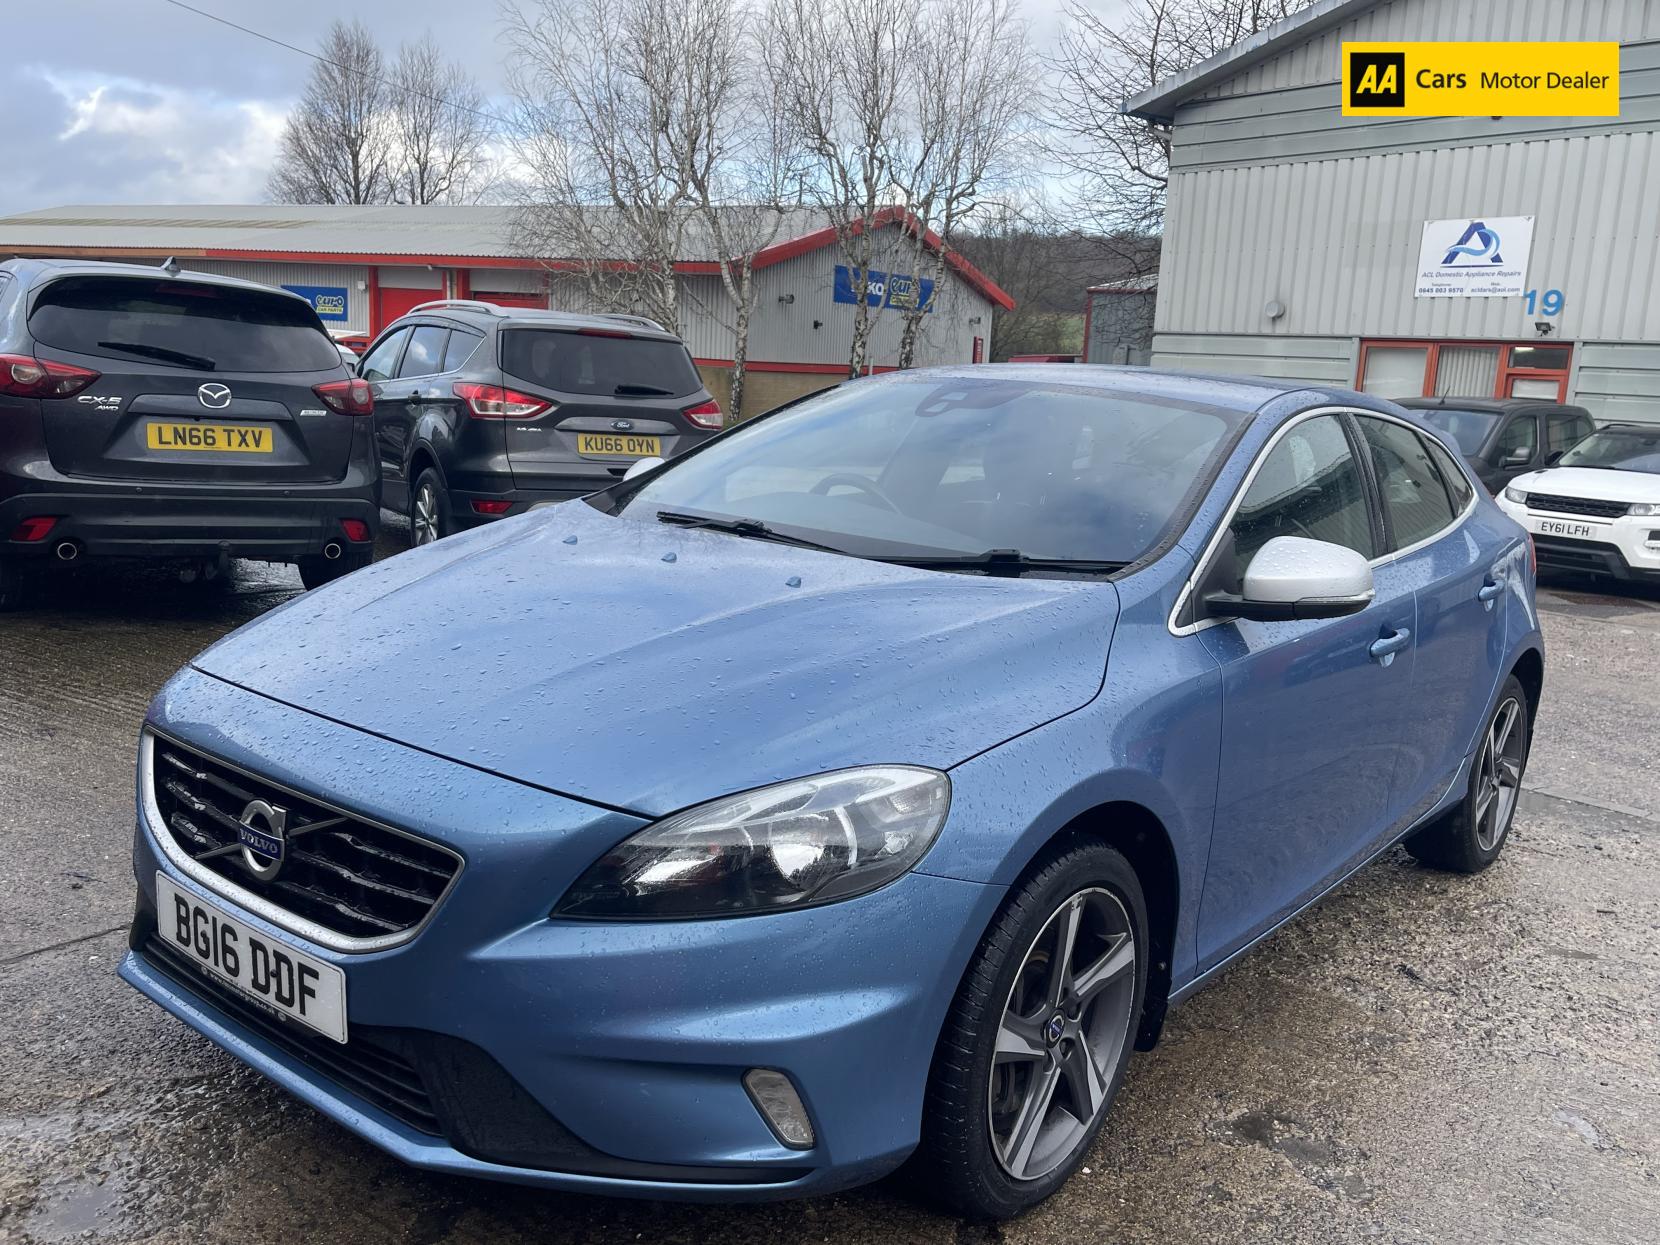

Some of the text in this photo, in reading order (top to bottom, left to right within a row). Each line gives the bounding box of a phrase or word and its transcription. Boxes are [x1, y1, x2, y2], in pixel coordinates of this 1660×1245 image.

[1523, 289, 1564, 317] 19
[78, 395, 122, 404] CX-5
[157, 426, 263, 448] LN66 TXV
[584, 436, 655, 453] KU66 OYN
[1541, 521, 1590, 536] EY61 LFH
[239, 828, 279, 854] VOLVO
[174, 892, 240, 978] BG16
[249, 936, 320, 1017] DDF
